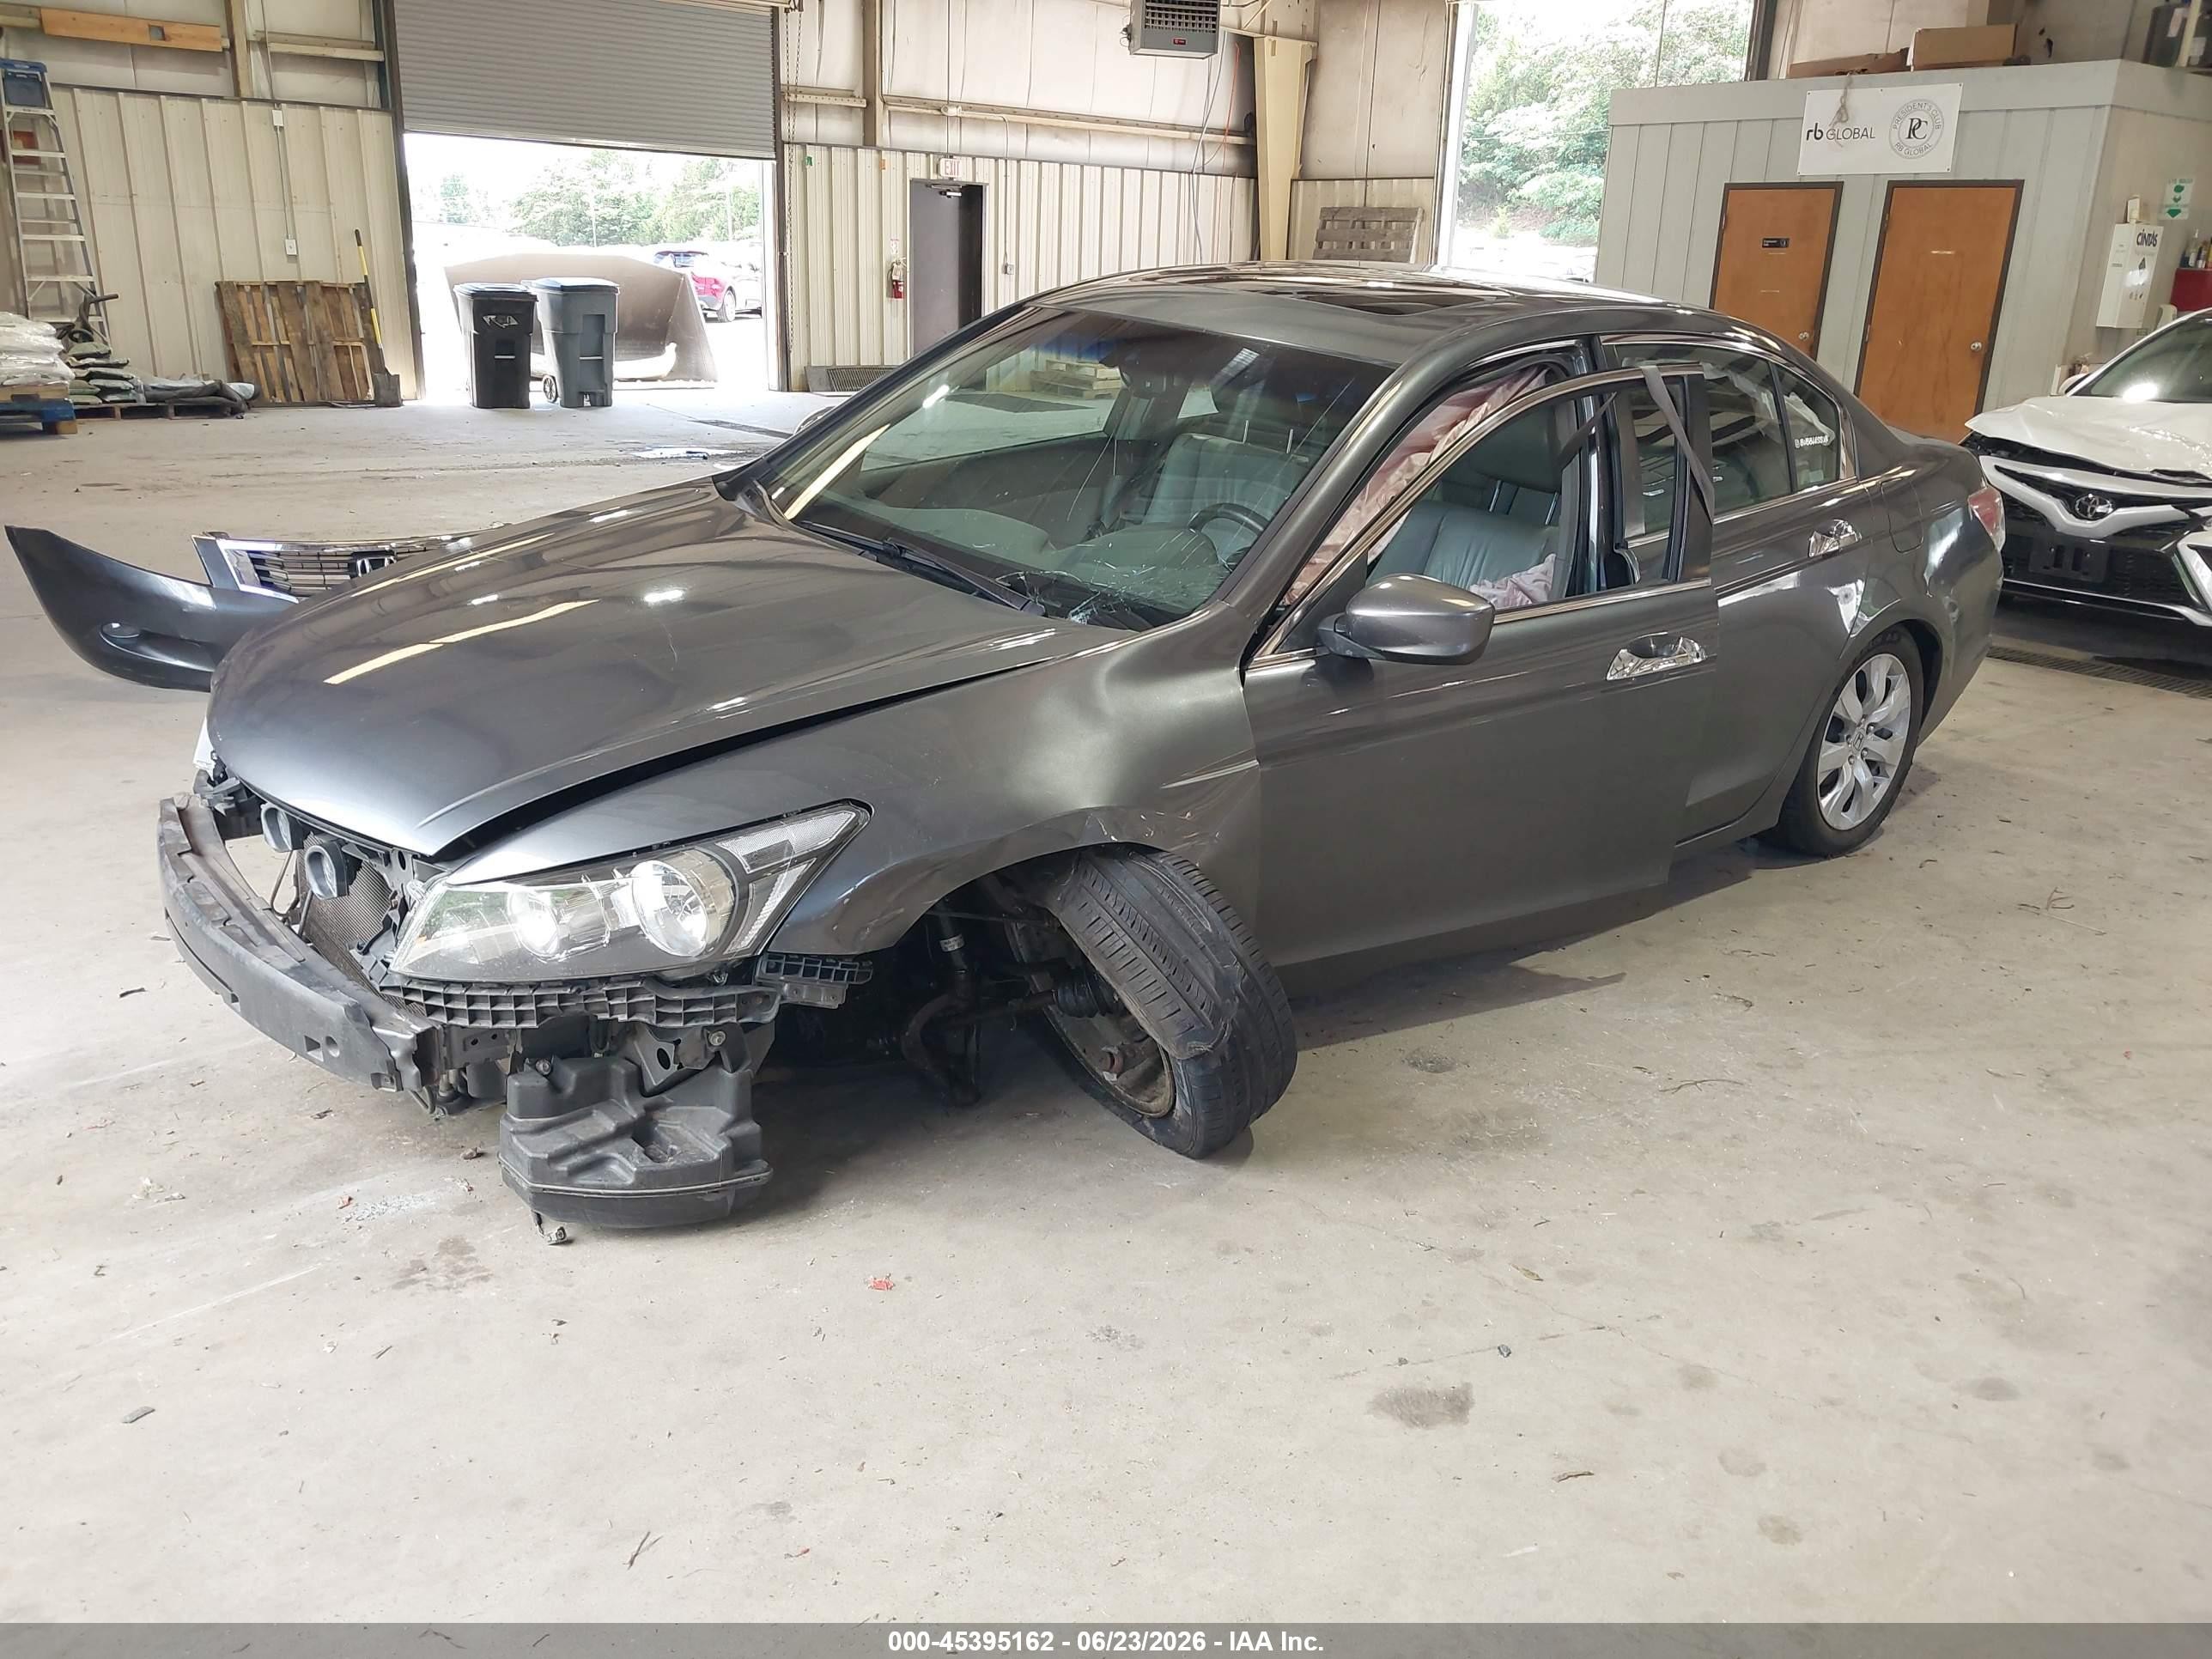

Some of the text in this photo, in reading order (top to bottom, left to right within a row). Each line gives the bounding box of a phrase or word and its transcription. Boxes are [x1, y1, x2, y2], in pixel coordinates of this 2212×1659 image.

[1931, 109, 1942, 130] CLUB
[1806, 122, 1876, 141] rb GLOBAL
[1894, 142, 1933, 156] RB GLOBAL
[945, 160, 960, 176] EXIT
